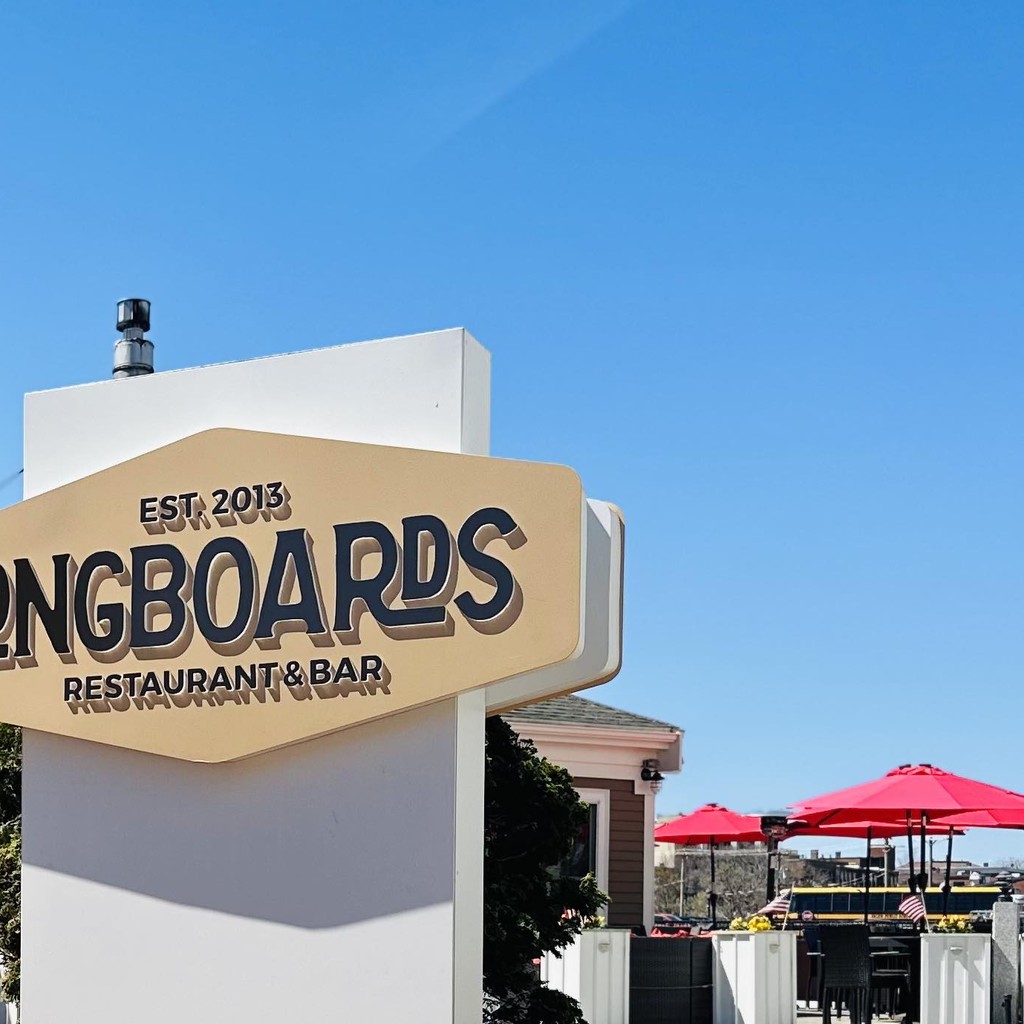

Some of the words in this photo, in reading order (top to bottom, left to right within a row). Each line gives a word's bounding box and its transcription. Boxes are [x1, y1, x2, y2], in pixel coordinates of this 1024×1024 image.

[140, 492, 204, 523] EST.
[212, 482, 284, 515] 2013
[64, 662, 279, 702] RESTAURANT
[309, 655, 383, 686] BAR
